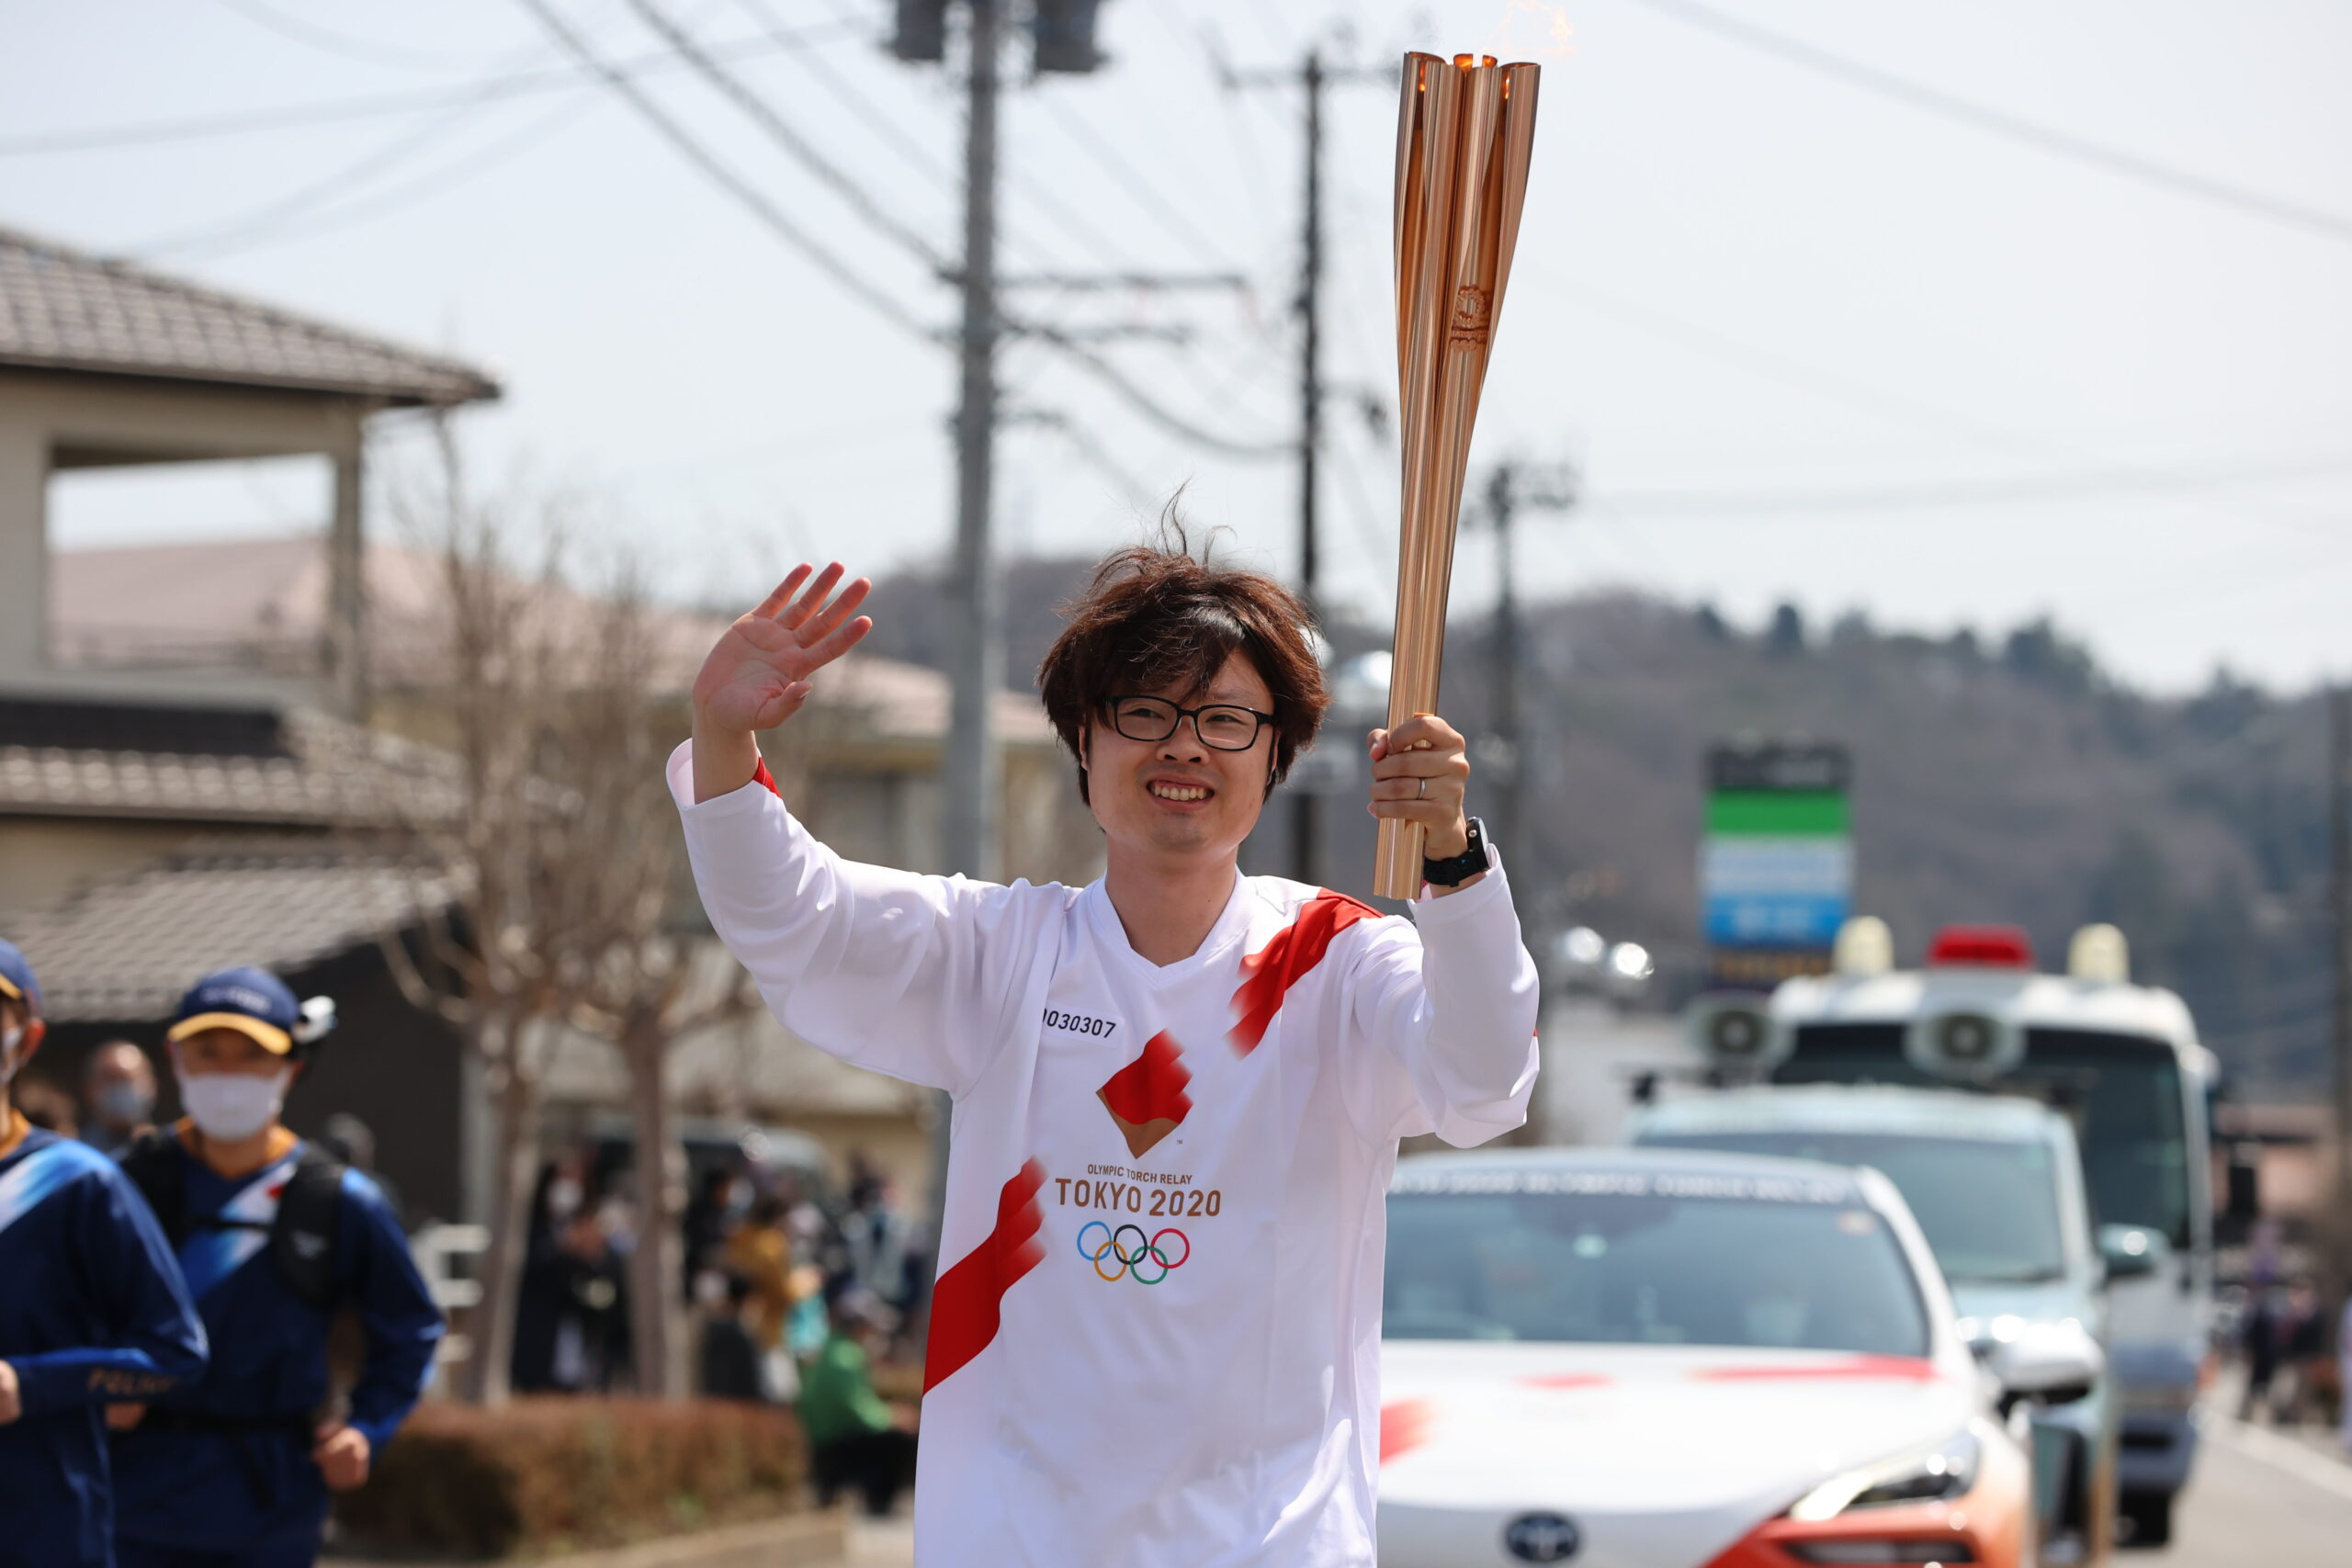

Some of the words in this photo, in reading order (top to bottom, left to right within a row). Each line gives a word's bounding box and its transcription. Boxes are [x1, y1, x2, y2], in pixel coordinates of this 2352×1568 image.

[1087, 1164, 1124, 1177] OLYMPIC
[1126, 1168, 1157, 1183] TORCH
[1159, 1174, 1193, 1185] RELAY
[1055, 1178, 1141, 1213] TOKYO
[1148, 1189, 1221, 1217] 2020
